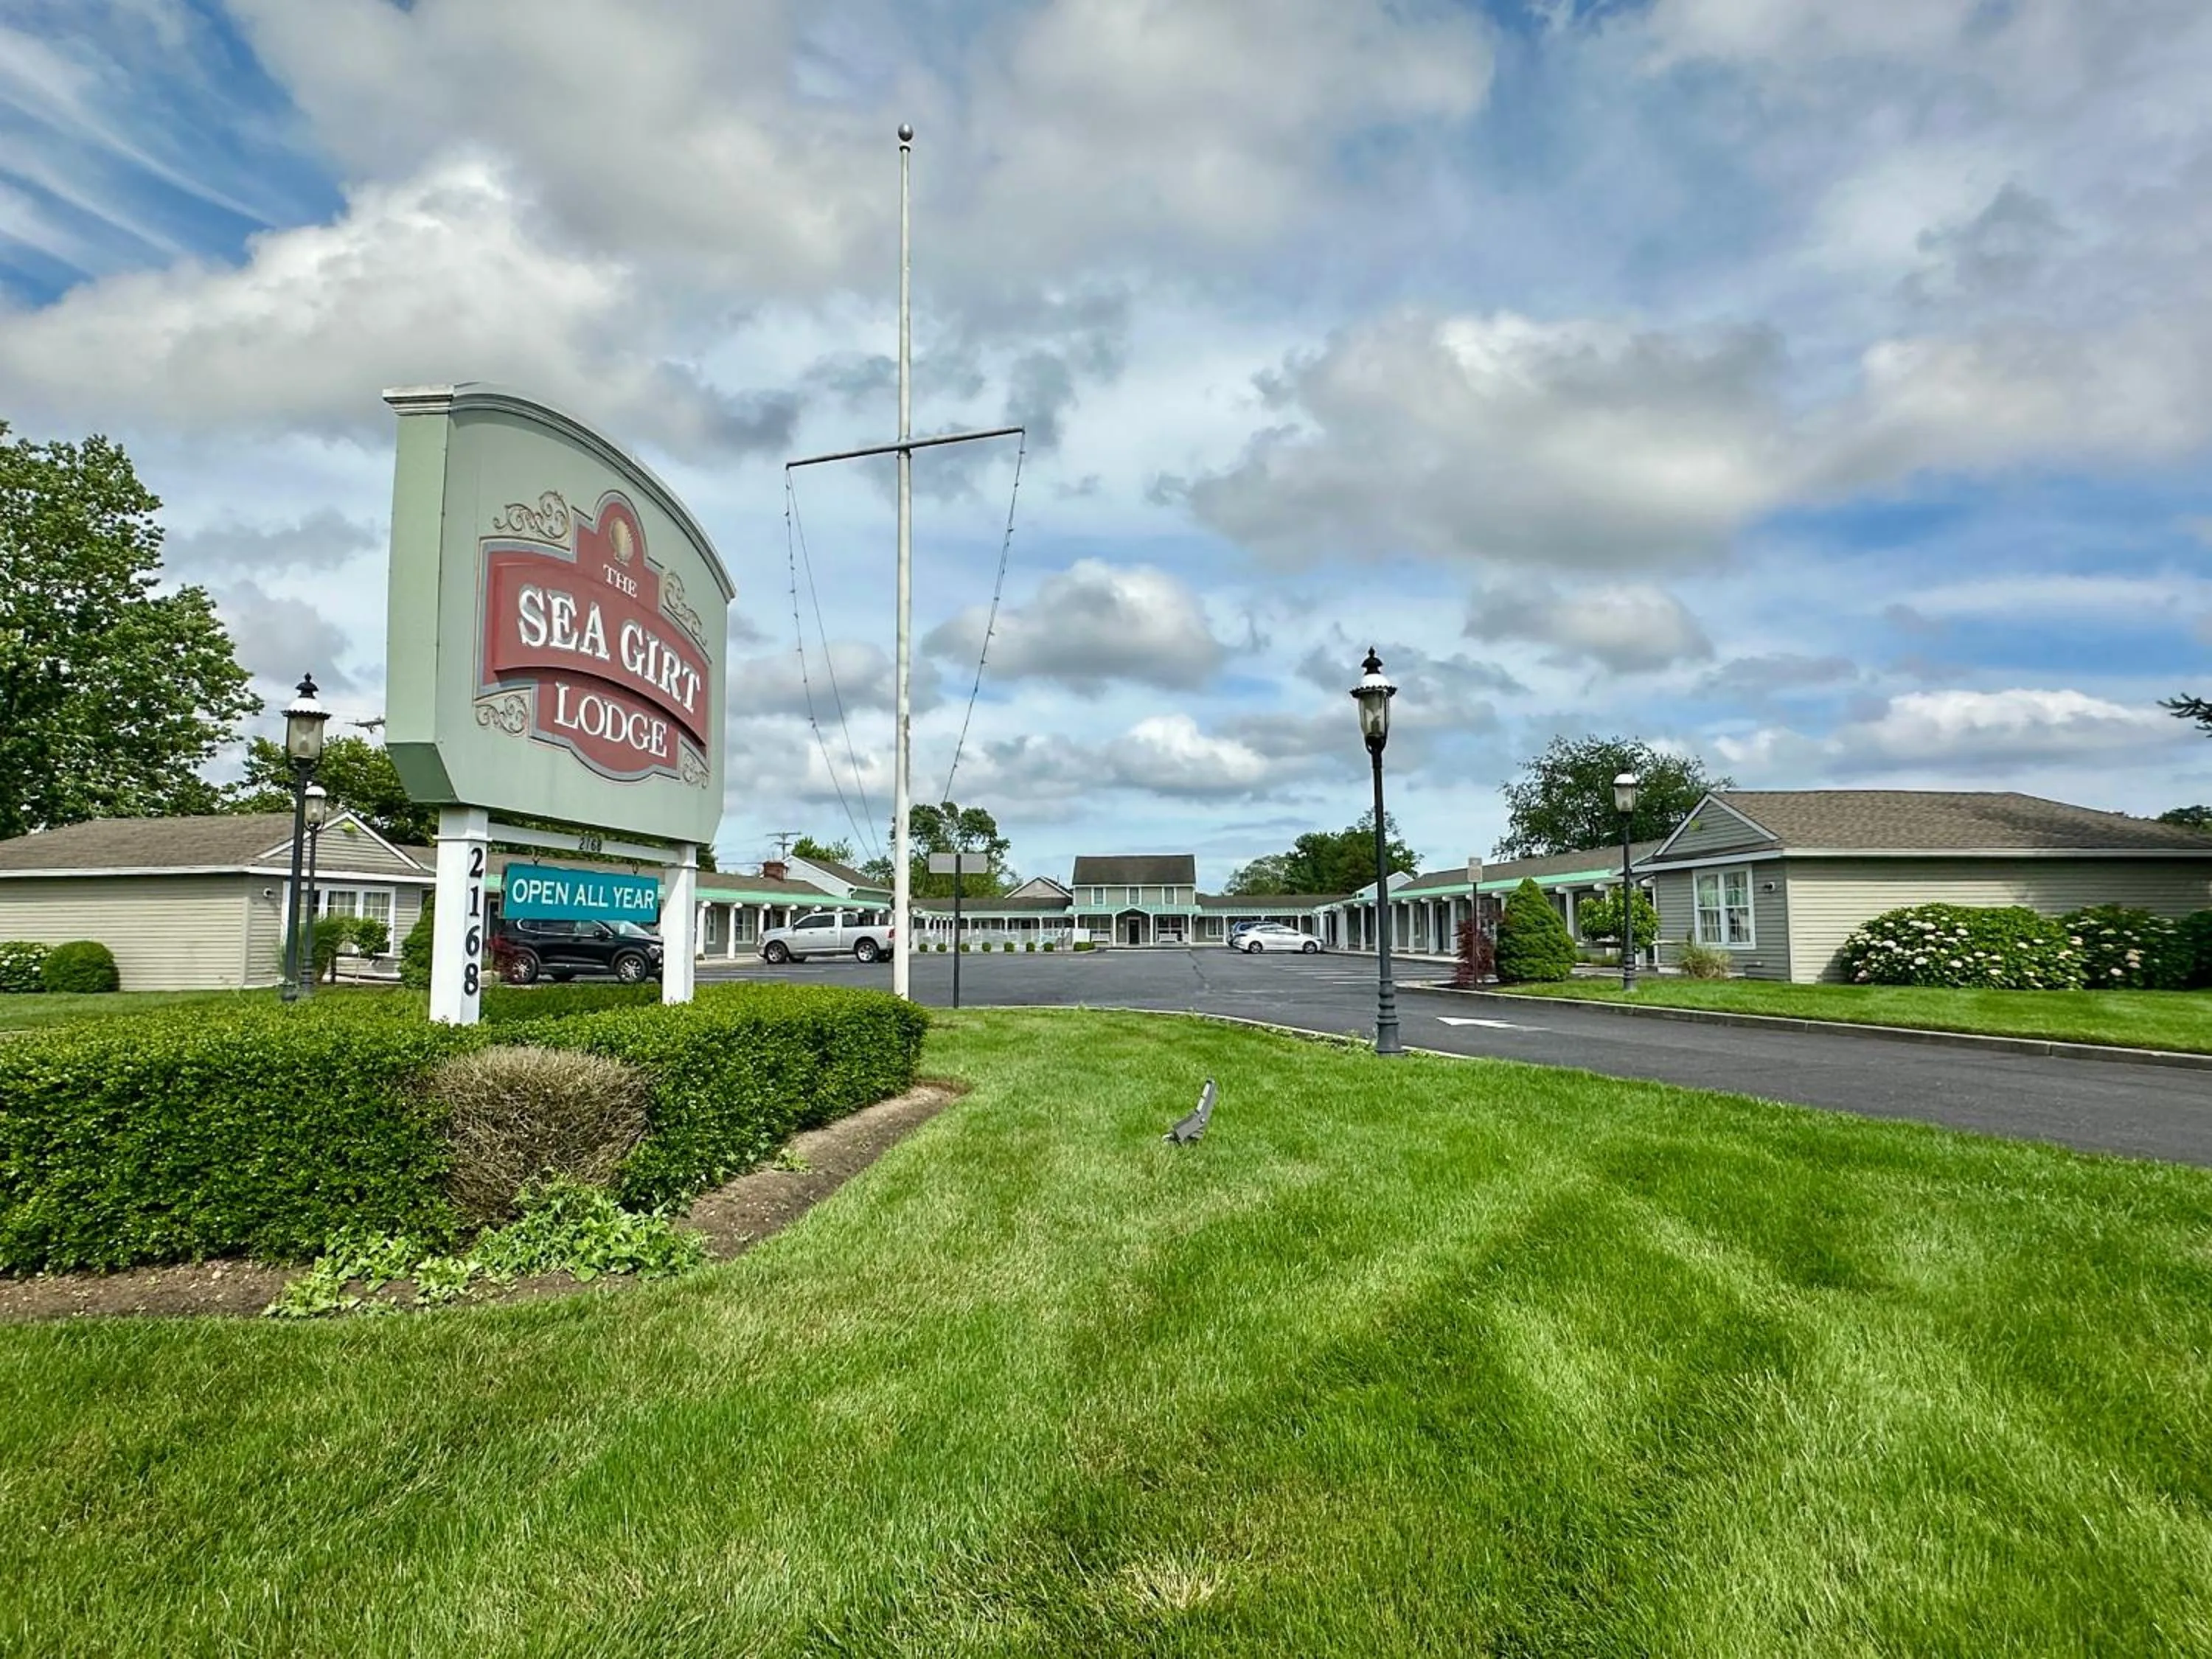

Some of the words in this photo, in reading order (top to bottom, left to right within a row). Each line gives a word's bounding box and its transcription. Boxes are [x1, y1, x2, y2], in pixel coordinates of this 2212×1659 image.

[602, 563, 637, 598] THE
[518, 588, 610, 661] SEA
[619, 622, 702, 714] GIRT
[554, 681, 667, 758] LODGE
[578, 836, 602, 852] 2168
[464, 847, 484, 995] 2168
[512, 877, 569, 906] OPEN
[574, 884, 608, 908] ALL
[613, 886, 655, 909] YEAR
